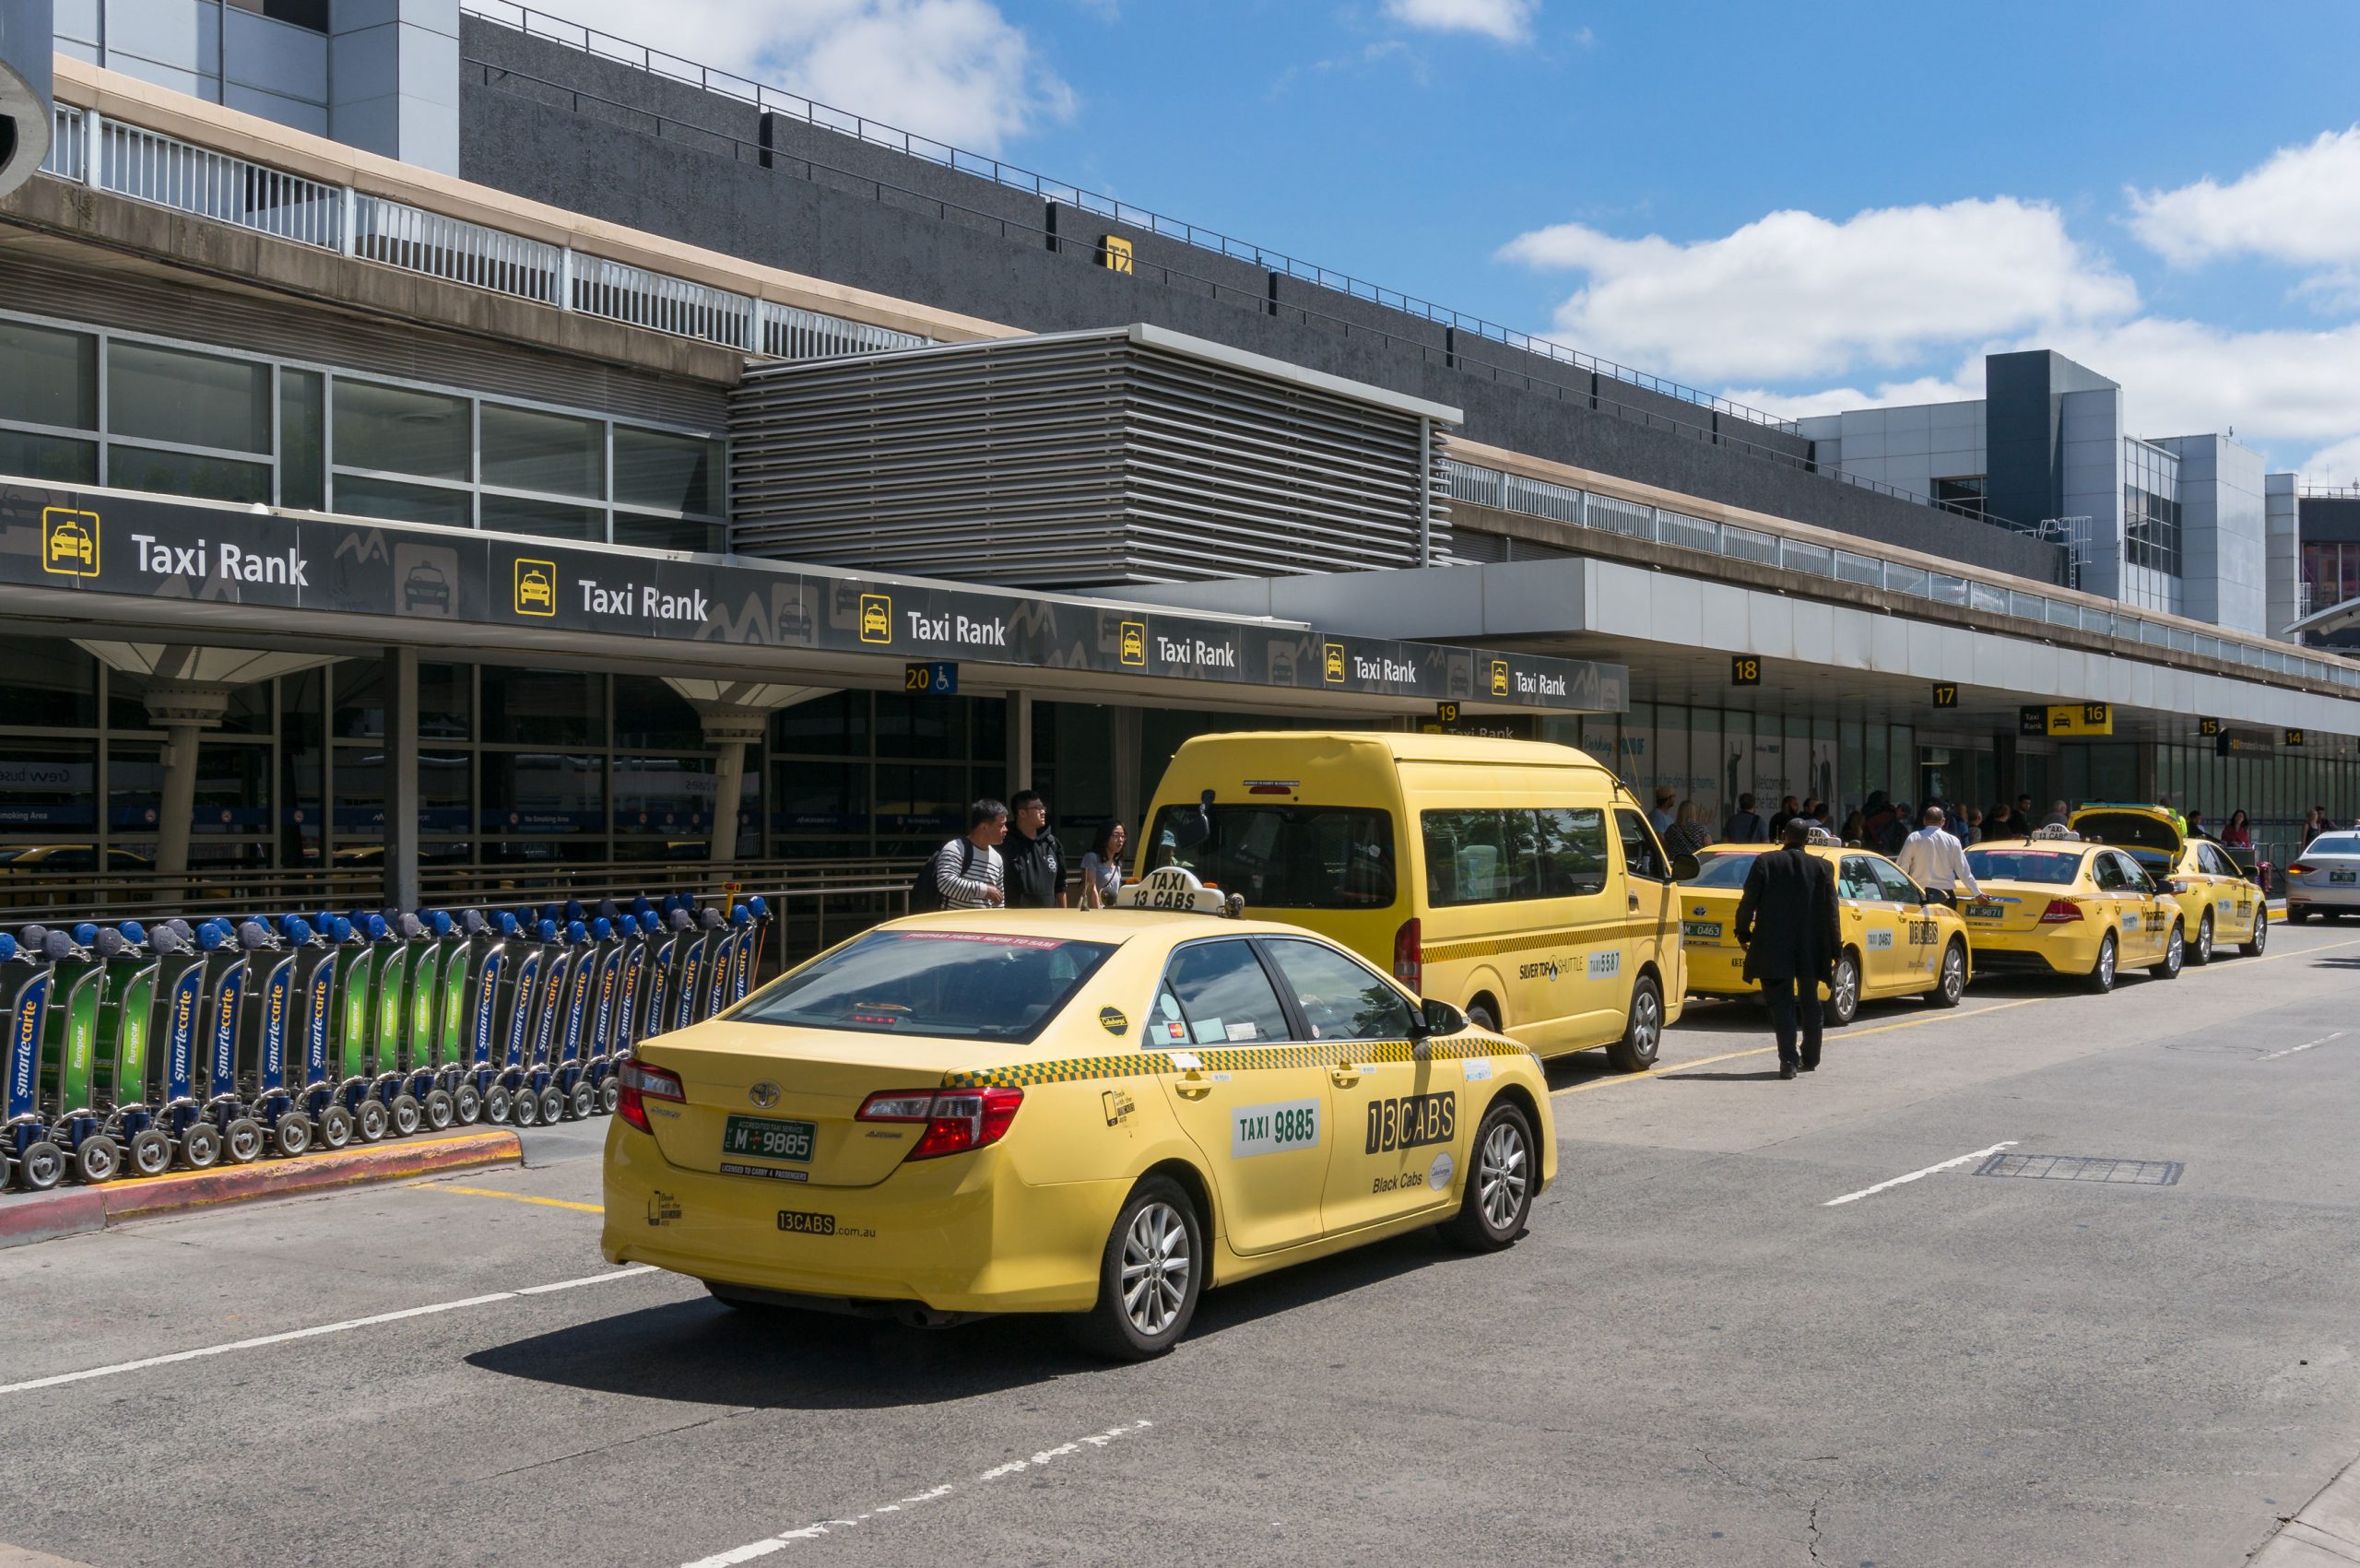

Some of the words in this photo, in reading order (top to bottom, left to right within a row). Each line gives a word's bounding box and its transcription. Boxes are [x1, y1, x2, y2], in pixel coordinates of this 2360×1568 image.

[1108, 244, 1130, 275] T2
[132, 535, 206, 577] Taxi
[220, 544, 309, 586] Rank
[578, 580, 632, 615] Taxi
[643, 586, 708, 621] Rank
[908, 611, 950, 642] Taxi
[957, 616, 1006, 646] Rank
[1158, 637, 1191, 664] Taxi
[1197, 641, 1235, 667] Rank
[906, 669, 929, 690] 20
[1354, 656, 1381, 680] Taxi
[1385, 660, 1417, 683] Rank
[1735, 661, 1757, 680] 18
[1516, 672, 1537, 693] Taxi
[1540, 675, 1566, 696] Rank
[1937, 687, 1954, 703] 17
[1439, 704, 1457, 722] 19
[2087, 706, 2104, 721] 16
[1480, 727, 1514, 739] Rank
[2201, 721, 2217, 735] 15
[2287, 732, 2302, 745] 14
[0, 812, 29, 820] moking
[30, 811, 48, 819] Area
[1151, 872, 1187, 891] TAXI
[1134, 890, 1149, 907] 13
[1154, 892, 1196, 910] CABS
[1697, 926, 1720, 936] 0463
[1878, 932, 1892, 947] 0463
[1909, 923, 1938, 943] 13CABS
[1519, 962, 1539, 980] SILVER
[1539, 961, 1550, 976] TOP
[1558, 956, 1584, 974] SHUTTLE
[1590, 960, 1600, 973] TAXI
[1600, 952, 1620, 973] 5587
[479, 969, 494, 1050] smartecarte
[513, 974, 531, 1053] smartecarte
[539, 975, 560, 1052] smartecarte
[569, 972, 587, 1048] smartecarte
[597, 969, 614, 1043] smartecarte
[620, 965, 637, 1039] smartecarte
[218, 987, 235, 1079] smartecarte
[268, 984, 283, 1074] smartecarte
[313, 981, 326, 1068] smartecarte
[350, 1001, 360, 1040] Europcar
[17, 1000, 36, 1098] smartecarte
[74, 1025, 84, 1068] Europcar
[127, 1021, 138, 1065] Europcar
[174, 989, 192, 1083] smartecarte
[738, 1121, 770, 1130] ACCREDITED
[782, 1125, 804, 1134] SERVICE
[1240, 1116, 1268, 1142] TAXI
[1274, 1108, 1315, 1144] 9885
[1369, 1096, 1454, 1149] 13CABS
[735, 1128, 749, 1149] M
[763, 1132, 809, 1156] 9885
[722, 1164, 744, 1173] LICENSED
[744, 1166, 751, 1174] TO
[751, 1167, 768, 1176] CARRY
[774, 1170, 808, 1181] PASSENGERS
[1372, 1175, 1398, 1195] Black
[1399, 1172, 1423, 1191] Cabs
